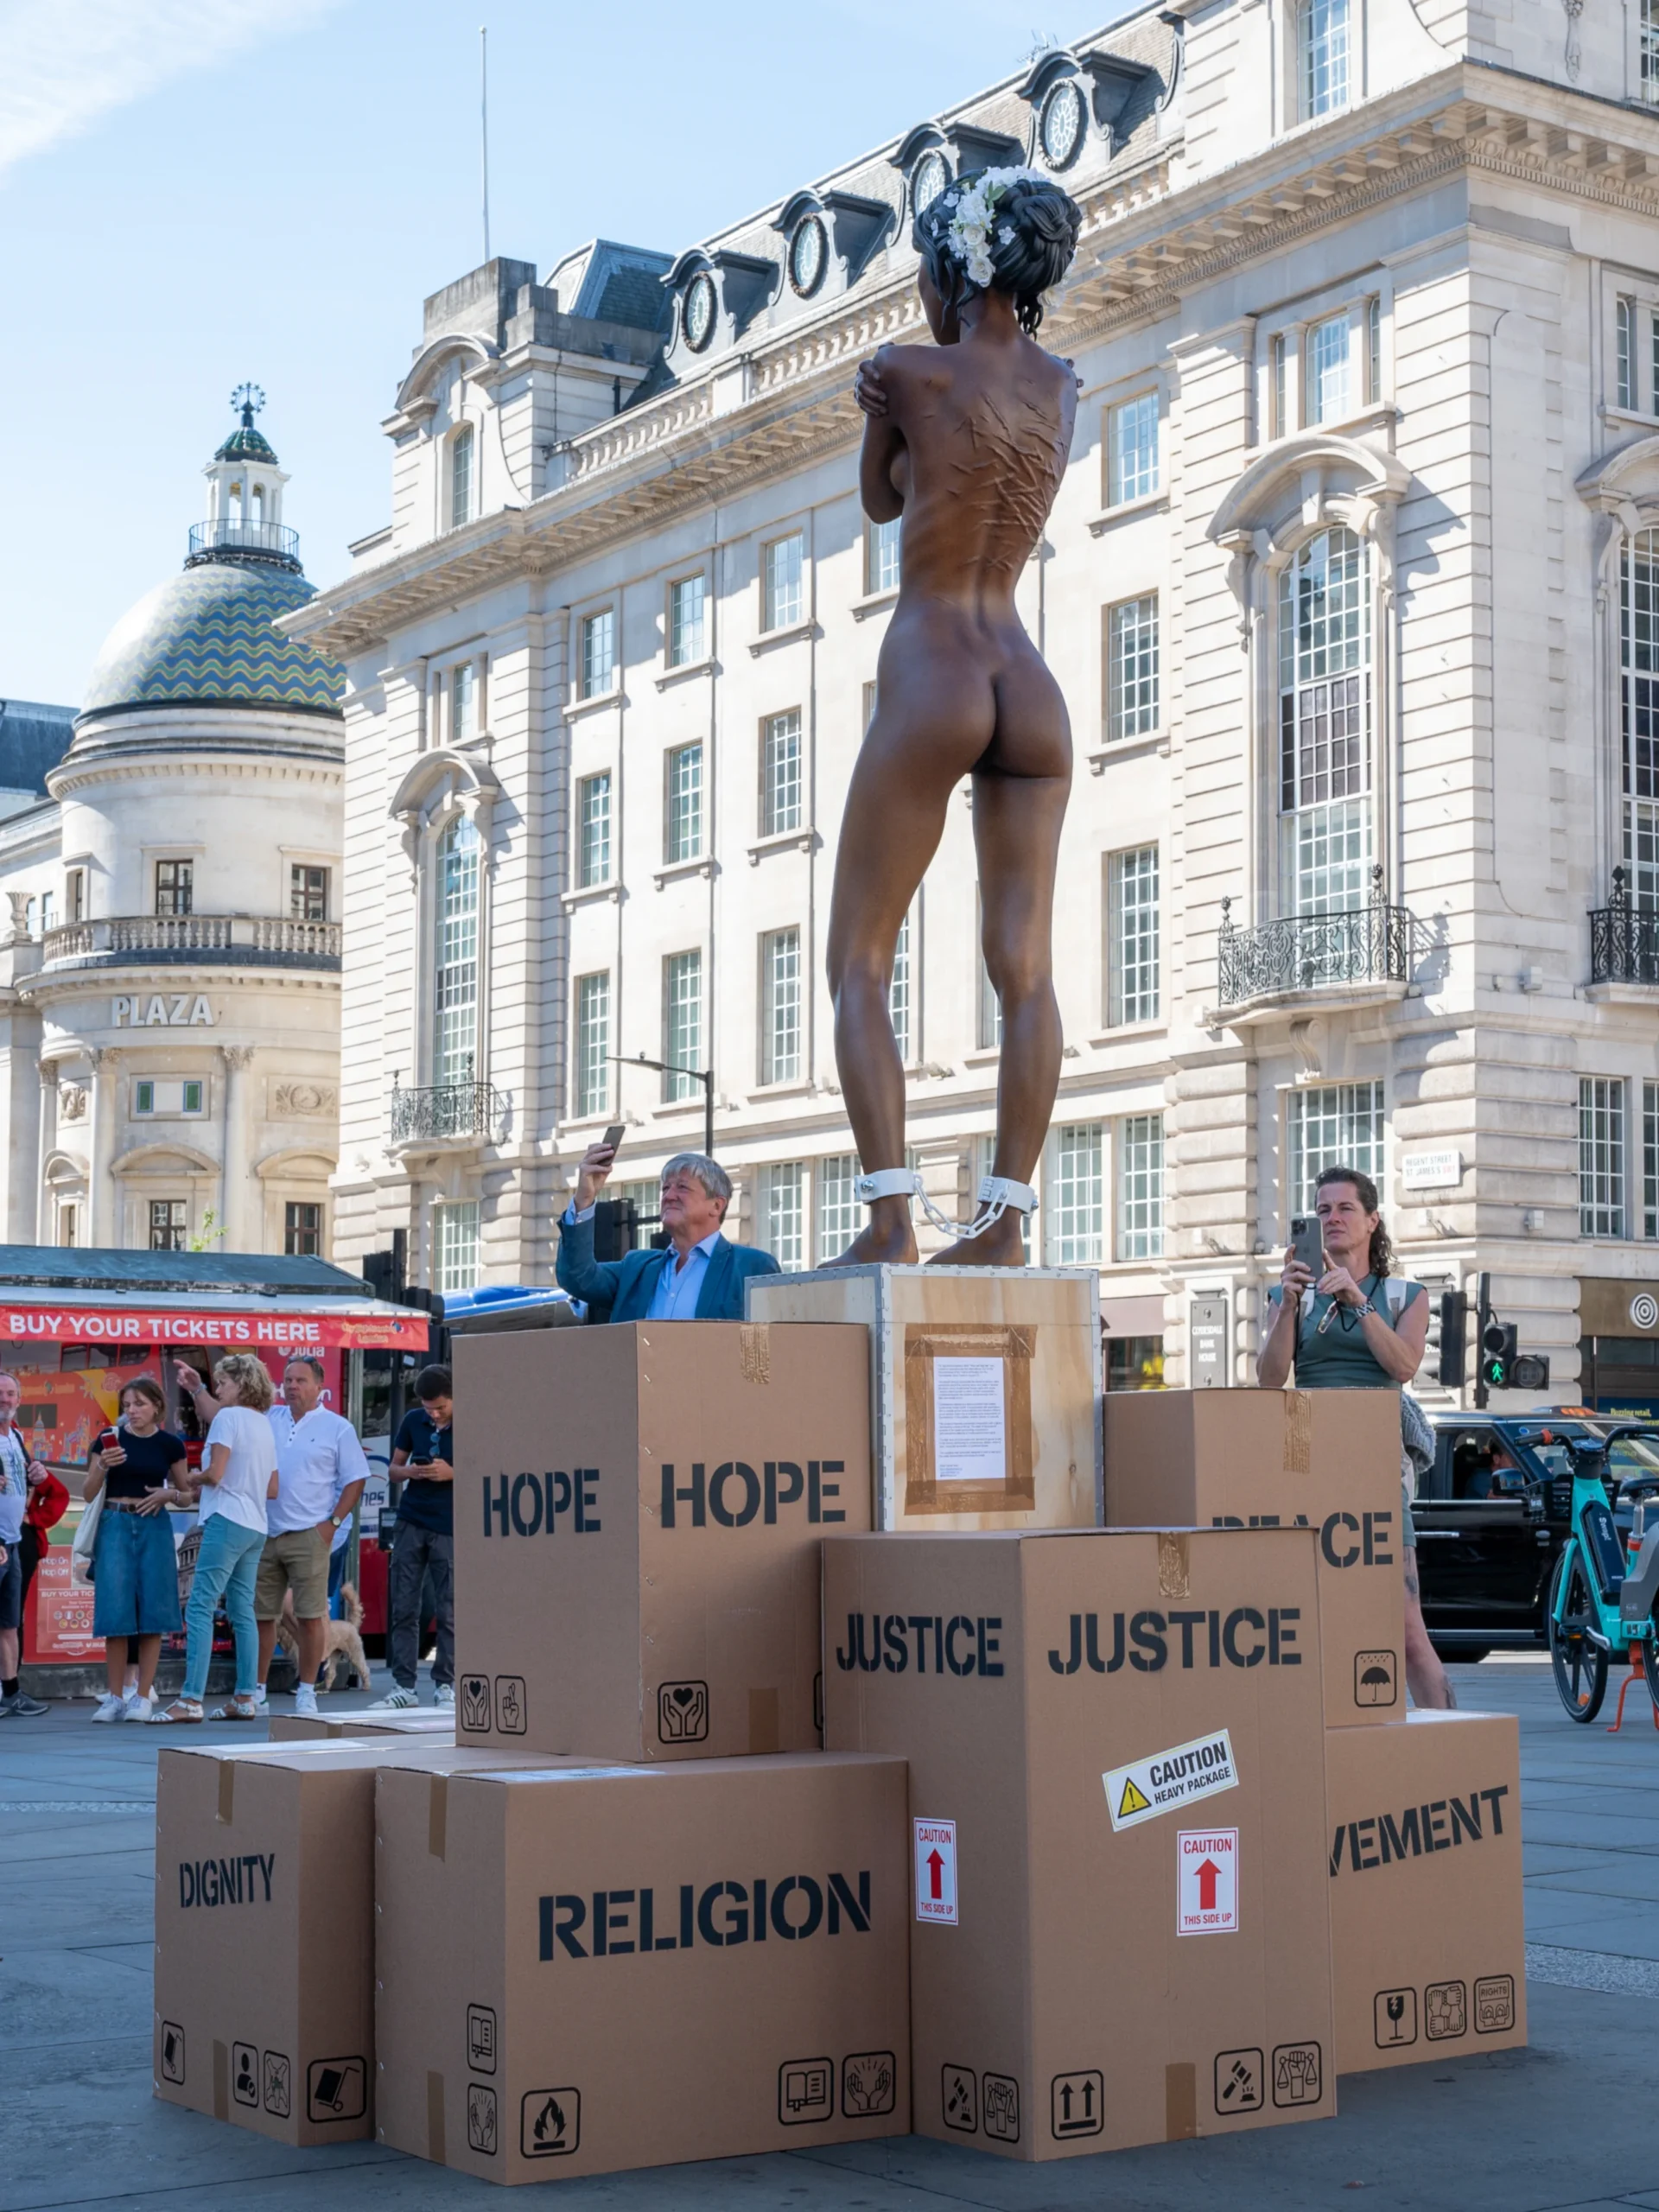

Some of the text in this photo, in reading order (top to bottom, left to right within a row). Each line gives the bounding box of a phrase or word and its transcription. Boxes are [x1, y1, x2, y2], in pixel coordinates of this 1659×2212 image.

[111, 994, 214, 1027] PLAZA
[1406, 1154, 1452, 1166] REGENT STREET
[10, 1314, 62, 1334] BUY
[69, 1316, 140, 1338] YOUR
[148, 1319, 251, 1339] TICKETS
[257, 1322, 320, 1341] HERE
[482, 1469, 601, 1537] HOPE
[660, 1460, 846, 1528] HOPE
[836, 1613, 1004, 1676] JUSTICE
[1048, 1607, 1302, 1675] JUSTICE
[1149, 1741, 1228, 1787] CAUTION
[1154, 1766, 1231, 1804] HEAVY PACKAGE
[918, 1827, 951, 1844] CAUTION
[1184, 1838, 1232, 1854] CAUTION
[180, 1853, 276, 1909] DIGNITY
[538, 1870, 871, 1961] RELIGION
[920, 1902, 953, 1915] THIS SIDE UP
[1184, 1912, 1232, 1925] THIS SIDE UP
[1481, 1986, 1508, 1997] RIGHTS
